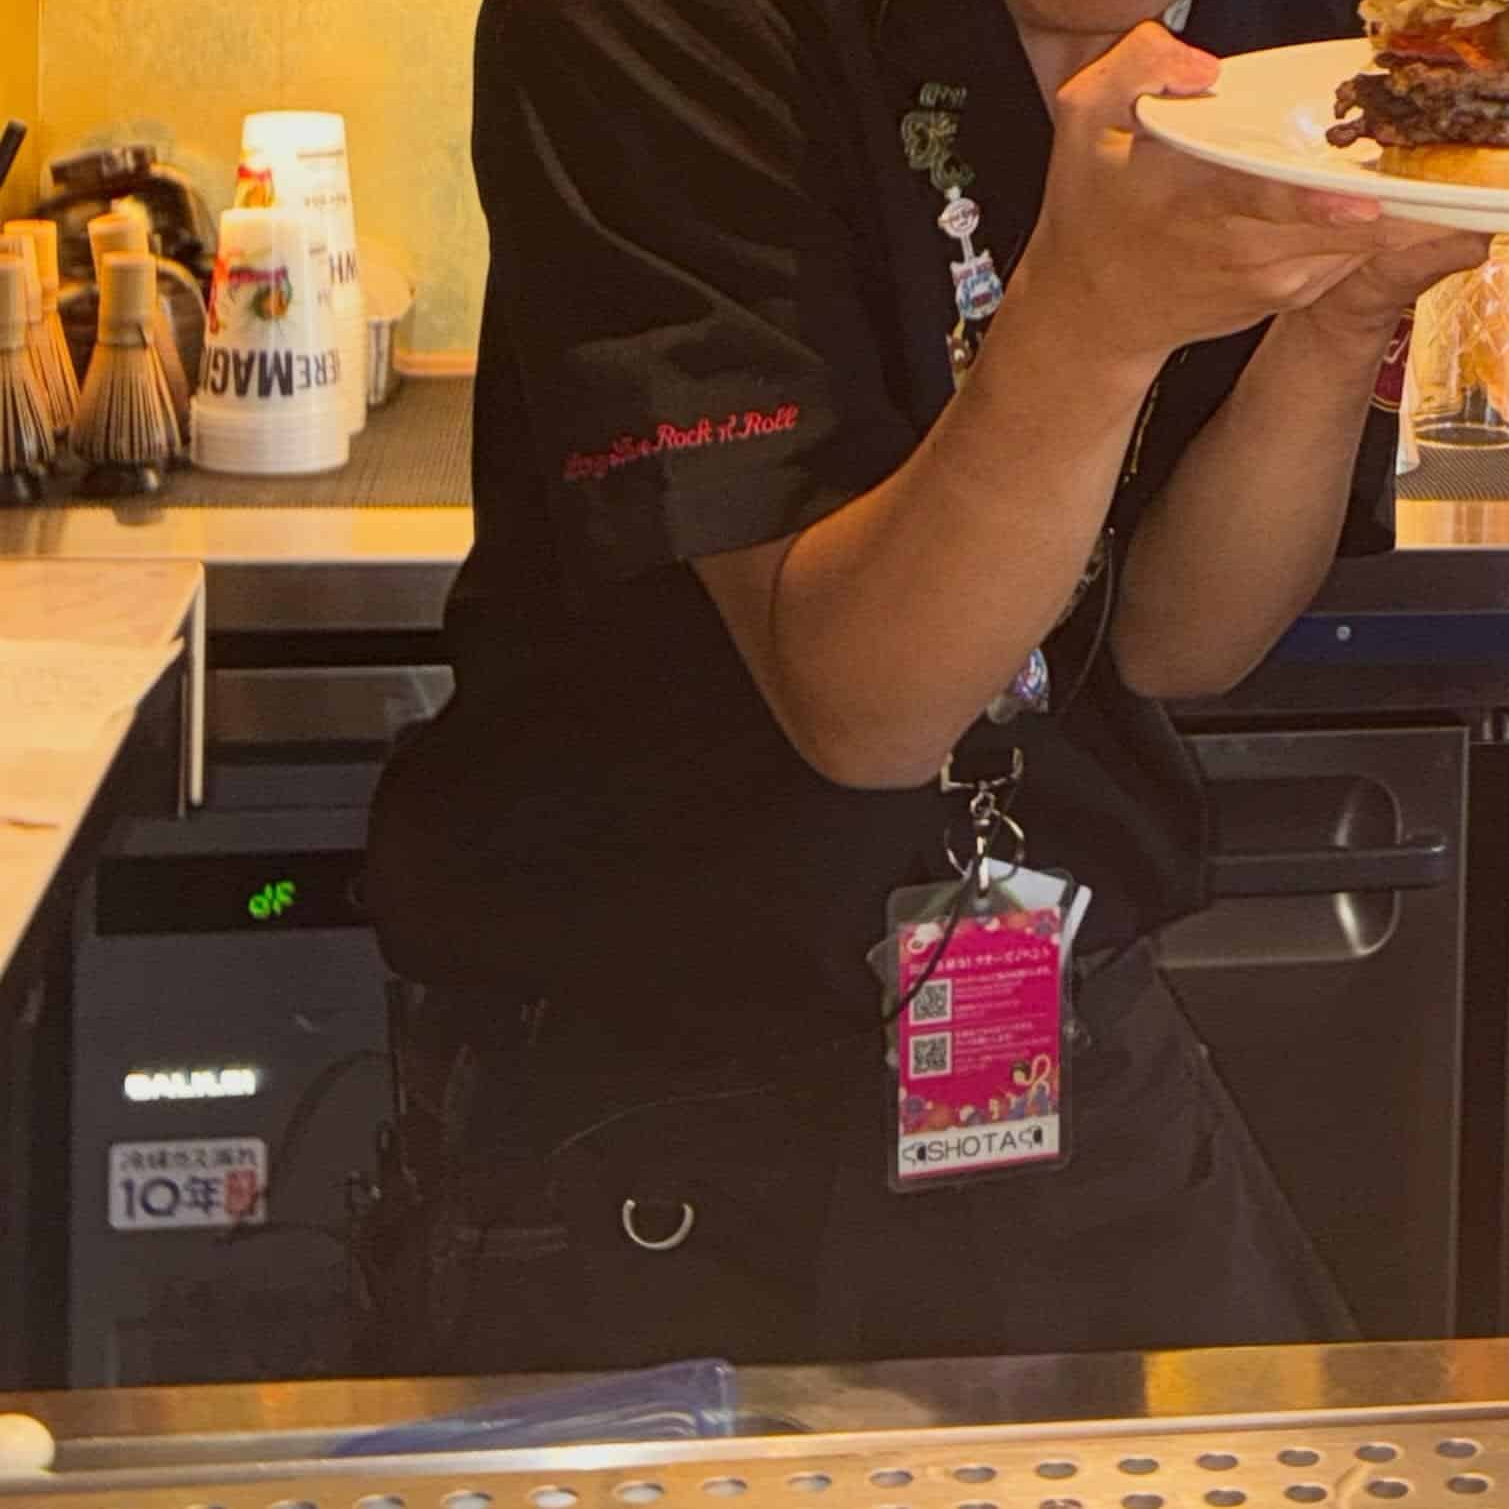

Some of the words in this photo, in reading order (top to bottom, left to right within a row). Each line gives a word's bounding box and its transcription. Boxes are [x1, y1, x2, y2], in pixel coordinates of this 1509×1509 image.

[651, 417, 714, 452] Rock
[737, 403, 800, 440] Roll
[926, 1129, 1018, 1163] SHOTA
